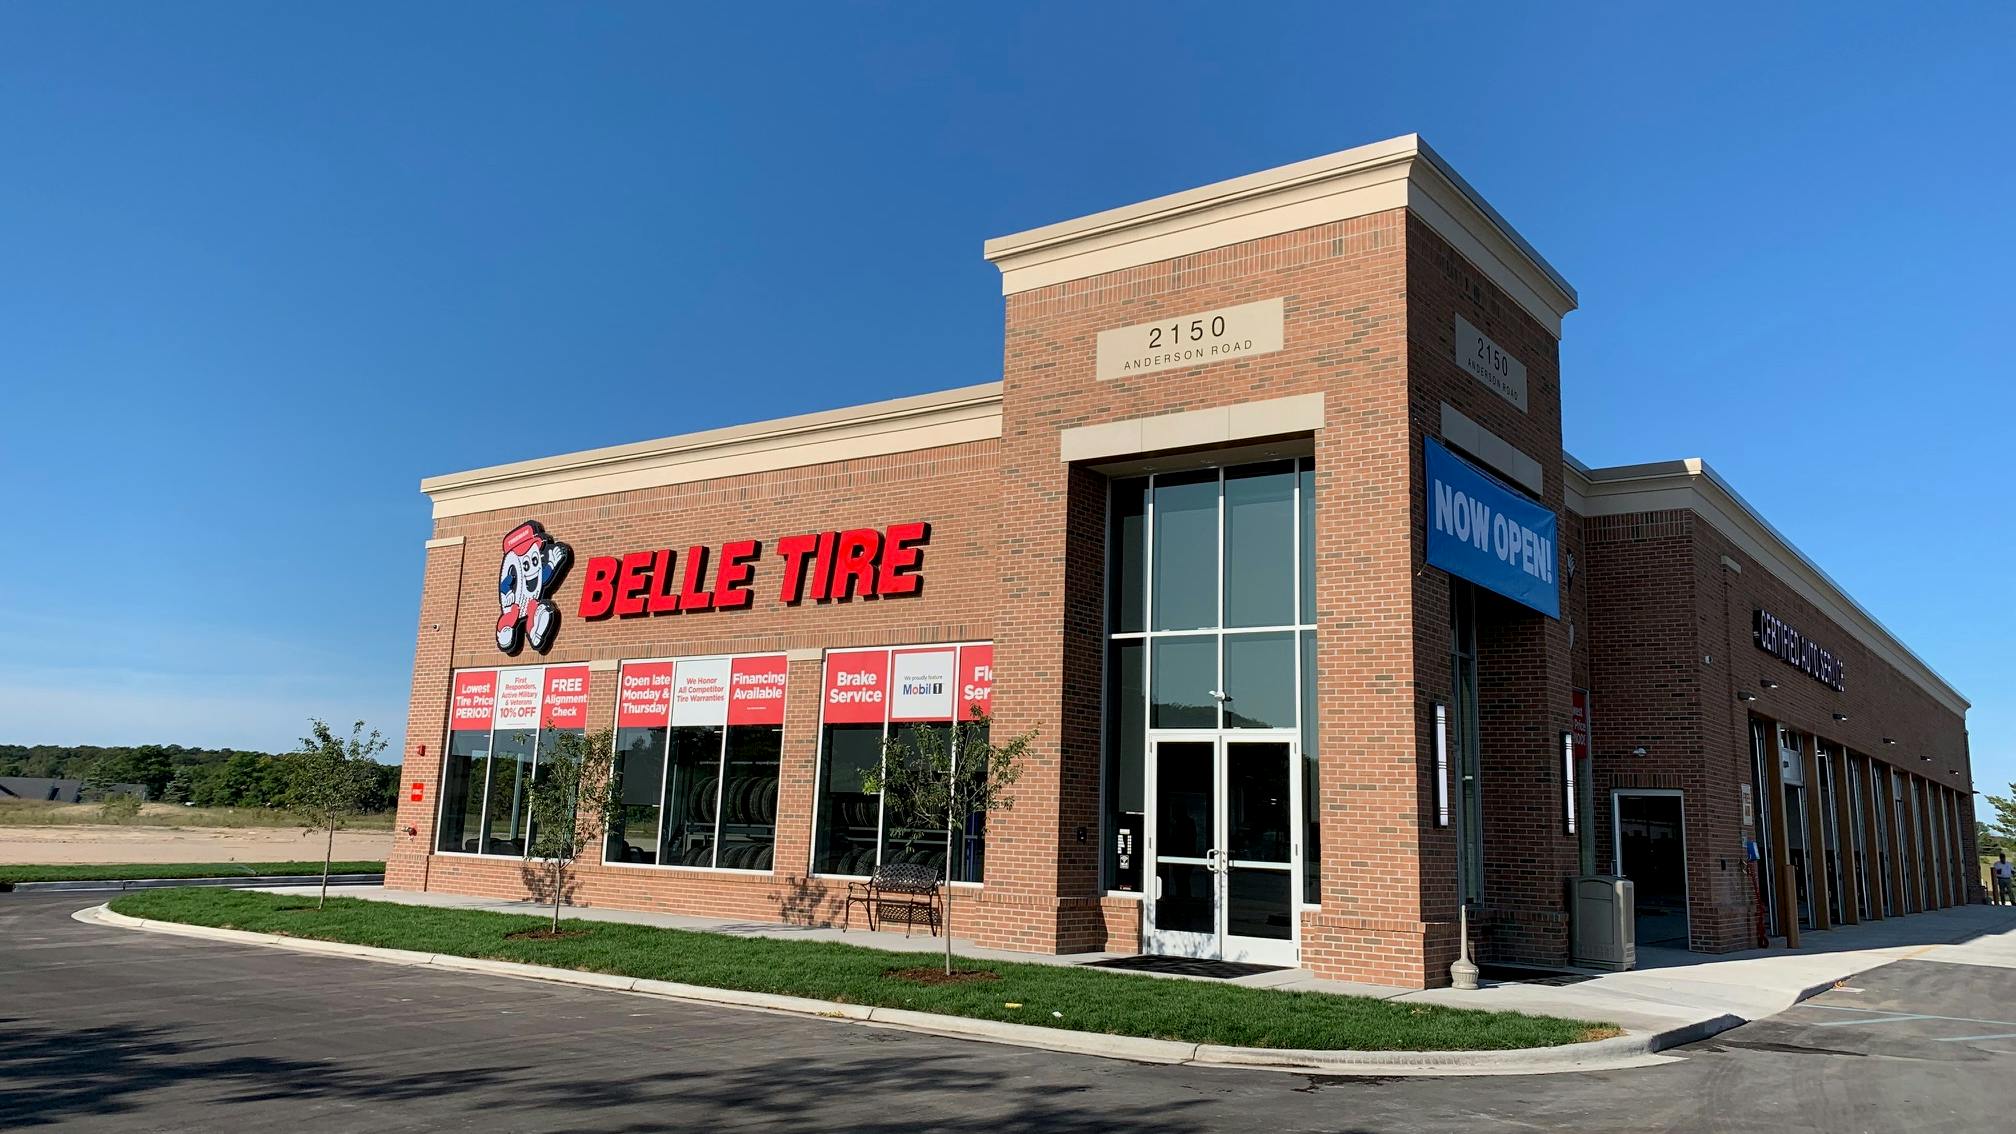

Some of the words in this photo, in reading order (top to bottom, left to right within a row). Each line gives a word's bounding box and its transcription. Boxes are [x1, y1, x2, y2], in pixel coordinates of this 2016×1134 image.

[1149, 315, 1225, 348] 2150
[1124, 348, 1204, 371] ANDERSON
[1211, 339, 1253, 356] ROAD
[1477, 337, 1508, 376] 2150
[1468, 357, 1501, 389] ANDERSON
[1502, 382, 1518, 400] ROAD
[1434, 478, 1490, 553] NOW
[1493, 512, 1552, 585] OPEN!
[577, 540, 760, 620] BELLE
[777, 522, 927, 602] TIRE
[1761, 609, 1800, 666] CERTIFIED
[1801, 636, 1820, 678] AUTO
[551, 678, 583, 692] FREE
[624, 676, 651, 687] Open
[652, 674, 670, 685] late
[732, 672, 786, 686] Financing
[836, 670, 877, 687] Brake
[462, 683, 490, 694] Lowest
[519, 690, 538, 699] Military
[623, 688, 660, 700] Monday
[662, 688, 670, 699] &
[678, 686, 687, 694] All
[688, 685, 724, 694] Competitor
[733, 686, 783, 700] Available
[903, 683, 931, 695] Mobil
[456, 696, 471, 706] Tire
[473, 695, 494, 706] Price
[544, 694, 588, 705] Alignment
[690, 694, 724, 702] Warranties
[829, 688, 882, 704] Service
[456, 707, 492, 719] PERIOD!
[500, 708, 516, 718] 10%
[518, 706, 536, 718] OFF
[552, 706, 577, 717] Check
[623, 702, 668, 715] Thursday
